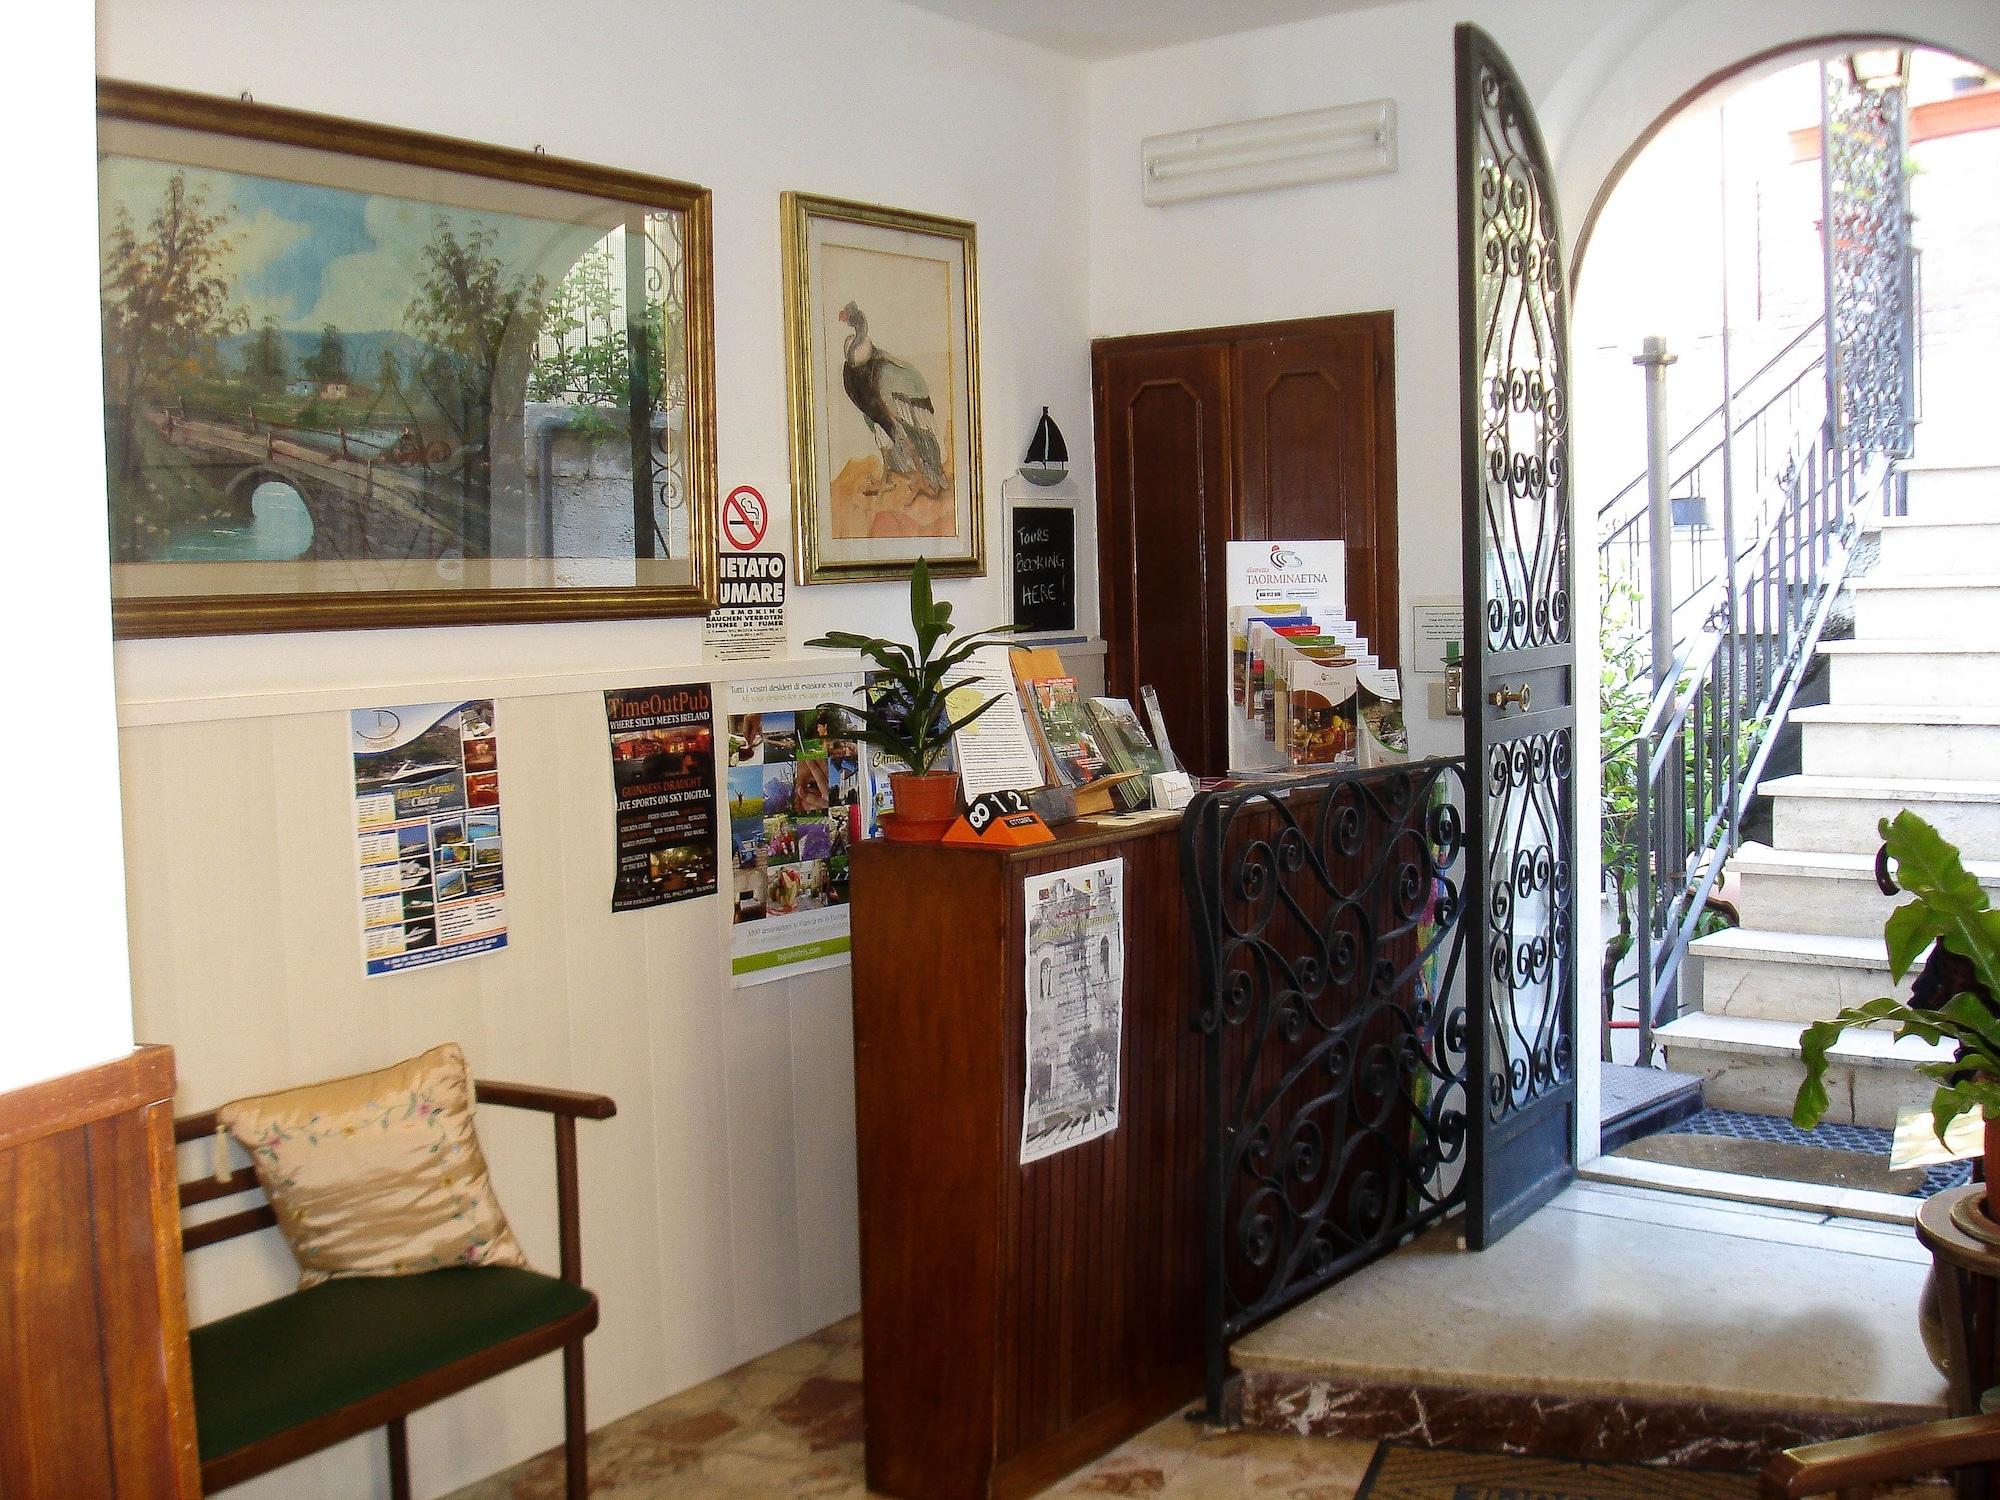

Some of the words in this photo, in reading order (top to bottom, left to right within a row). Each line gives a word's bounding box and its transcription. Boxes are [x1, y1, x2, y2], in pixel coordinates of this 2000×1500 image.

[720, 557, 783, 578] IETATO
[1015, 552, 1065, 573] BOOKING
[719, 582, 783, 604] UMARE
[610, 718, 635, 730] WHERE
[635, 716, 656, 727] SICILY
[657, 713, 680, 725] MEETS
[680, 711, 710, 722] IRELAND
[631, 796, 657, 809] SPORTS
[658, 795, 669, 804] ON
[669, 792, 684, 803] SKY
[969, 802, 990, 828] 8
